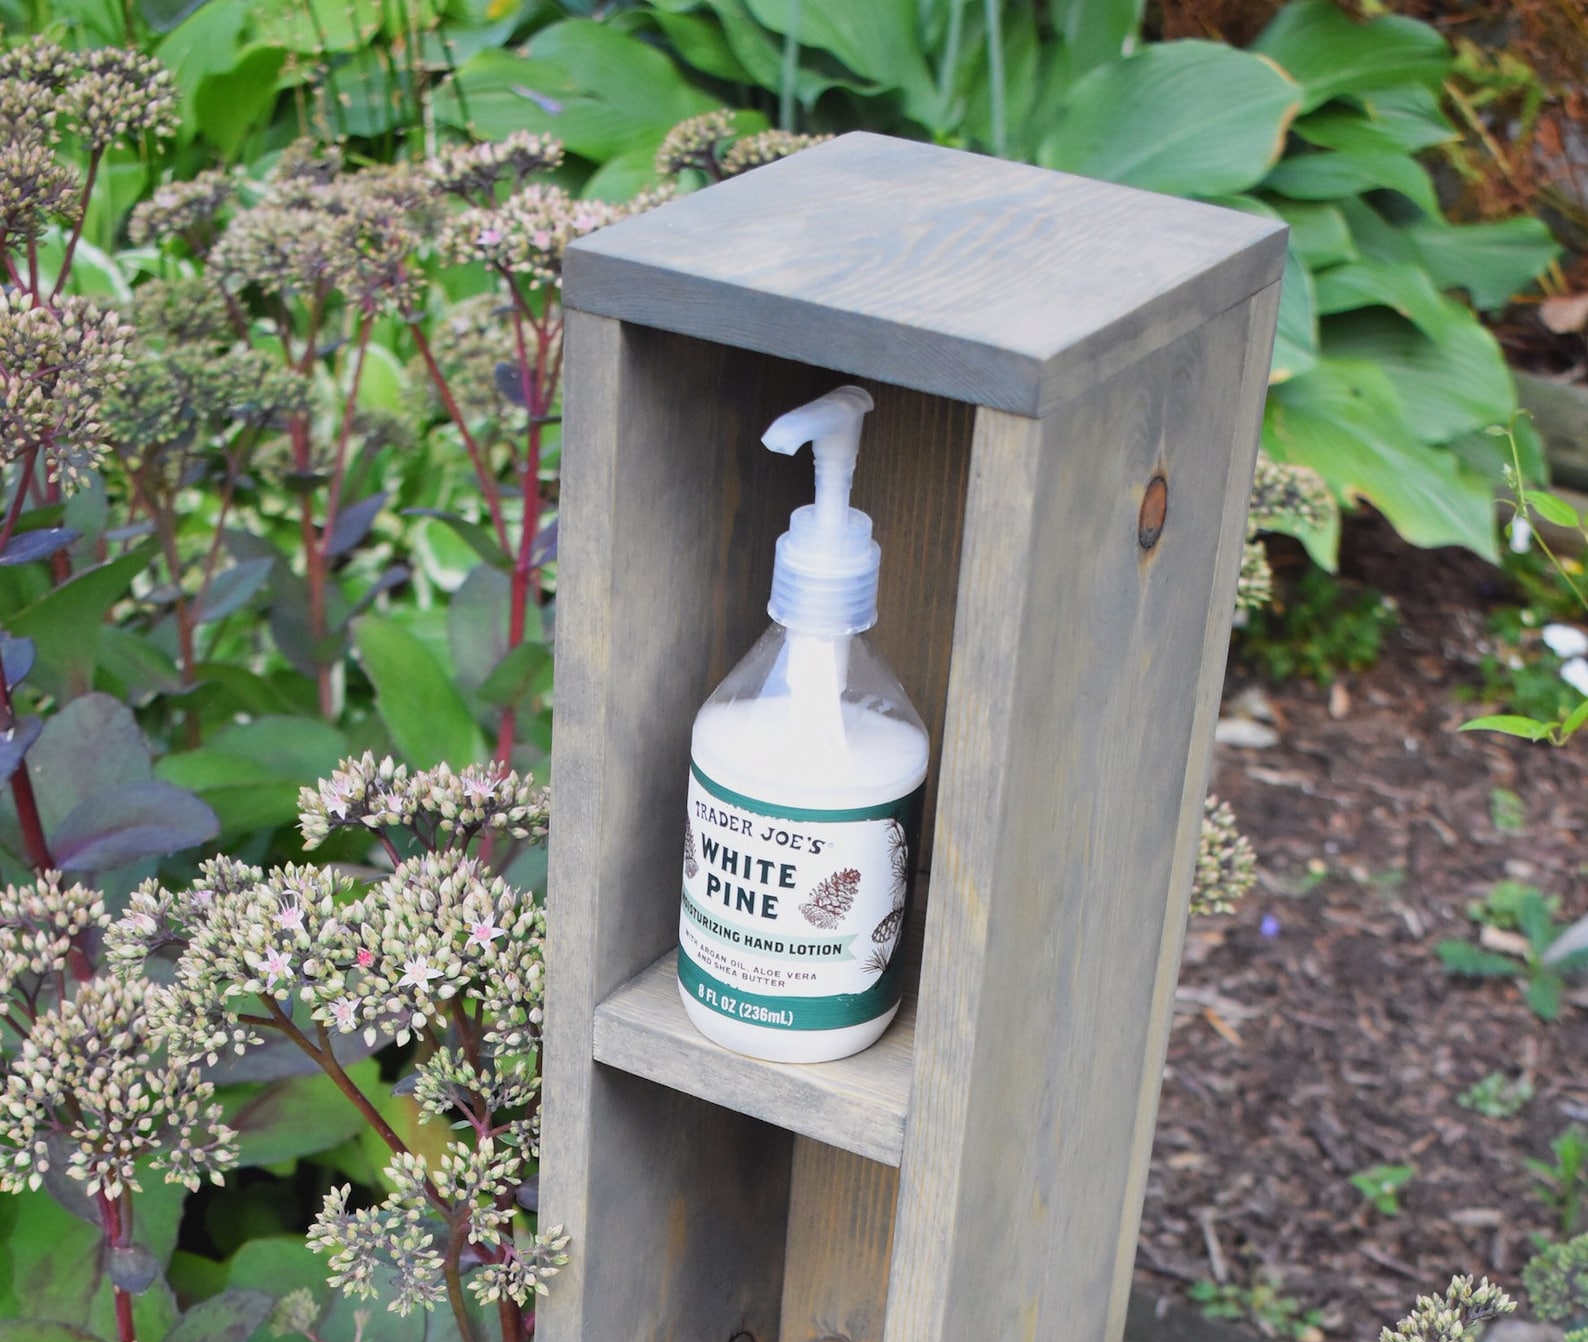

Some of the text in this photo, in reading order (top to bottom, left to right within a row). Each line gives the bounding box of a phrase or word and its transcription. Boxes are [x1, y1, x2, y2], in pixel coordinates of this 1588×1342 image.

[696, 801, 825, 854] TRADER JOE'S
[701, 832, 797, 889] WHITE
[706, 873, 779, 920] PINE
[700, 944, 727, 963] ARGAN
[753, 966, 781, 978] ALOE
[787, 972, 817, 980] VERA
[744, 935, 784, 953] HAND
[789, 943, 842, 956] LOTION
[697, 952, 785, 988] AND SHEA BUTTER
[697, 984, 794, 1027] 8 FL OZ (236mL)
